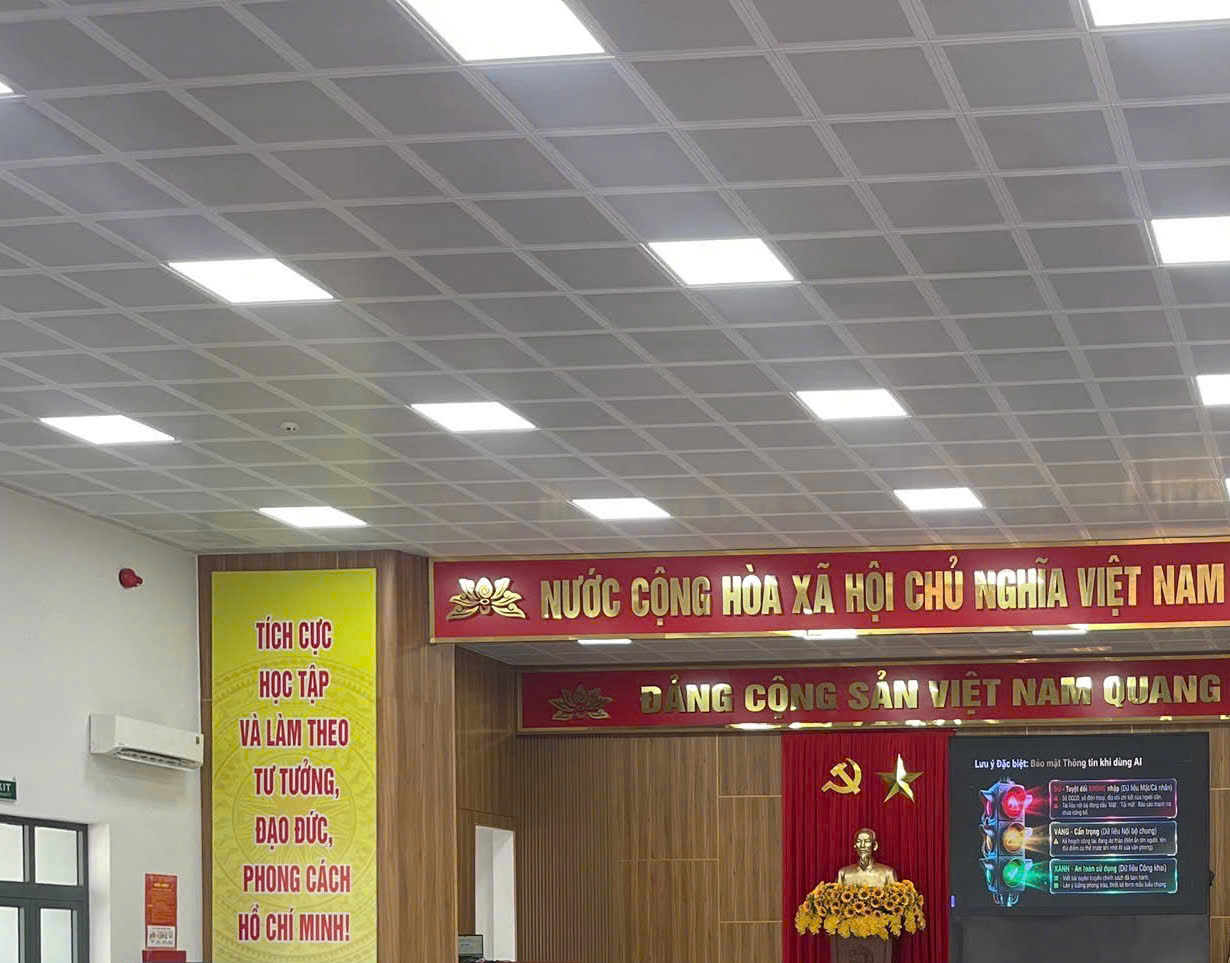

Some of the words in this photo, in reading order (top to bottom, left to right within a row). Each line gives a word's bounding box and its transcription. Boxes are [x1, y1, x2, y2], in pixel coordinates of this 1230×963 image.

[540, 567, 620, 619] NƯỚC
[631, 567, 710, 625] CỘNG
[721, 564, 782, 615] HÒA
[791, 562, 834, 615] XÃ
[845, 561, 895, 622] HỘI
[905, 555, 964, 612] CHỦ
[973, 558, 1068, 609] NGHĨA
[1077, 555, 1141, 616] VIỆT
[1153, 564, 1225, 606] NAM
[256, 617, 292, 649] TÍCH
[299, 620, 332, 655] CỰC
[259, 670, 292, 704] HỌC
[298, 665, 329, 704] TẬP
[640, 673, 734, 713] ĐẢNG
[744, 675, 836, 718] CỘNG
[847, 668, 918, 712] SẢN
[927, 671, 1001, 716] VIỆT
[1013, 676, 1092, 706] NAM
[1103, 673, 1221, 708] QUANG
[240, 712, 260, 746] VÀ
[267, 712, 302, 746] LÀM
[308, 719, 348, 746] THEO
[254, 766, 276, 795] TƯ
[280, 758, 339, 799] TƯỞNG,
[255, 816, 289, 849] ĐẠO
[295, 811, 333, 847] ĐỨC,
[243, 864, 300, 893] PHONG
[306, 859, 351, 892] CÁCH
[238, 903, 260, 941] HỒ
[266, 907, 293, 941] CHÍ
[300, 913, 350, 941] MINH!
